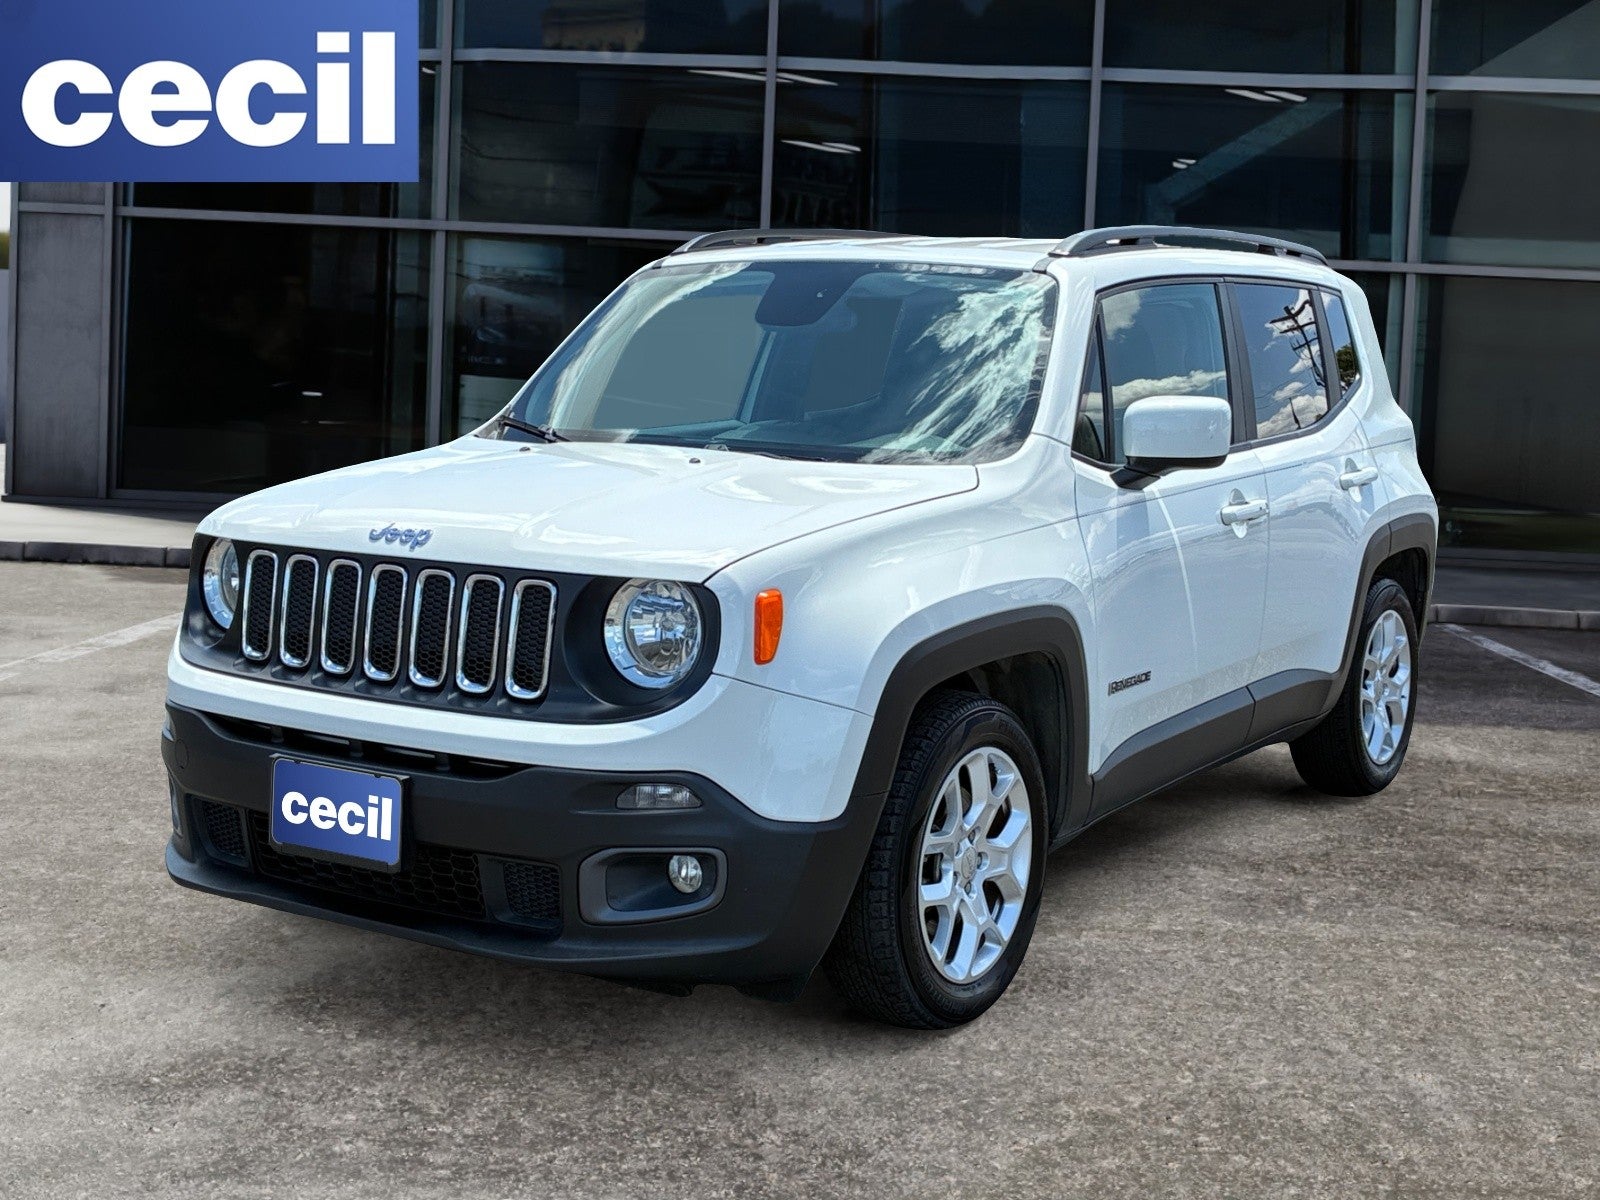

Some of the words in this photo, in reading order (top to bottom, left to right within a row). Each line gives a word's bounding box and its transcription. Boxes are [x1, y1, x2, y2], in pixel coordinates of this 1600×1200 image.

[369, 522, 432, 551] Jeep
[1109, 670, 1151, 695] RENEGADE
[281, 791, 393, 841] cecil
